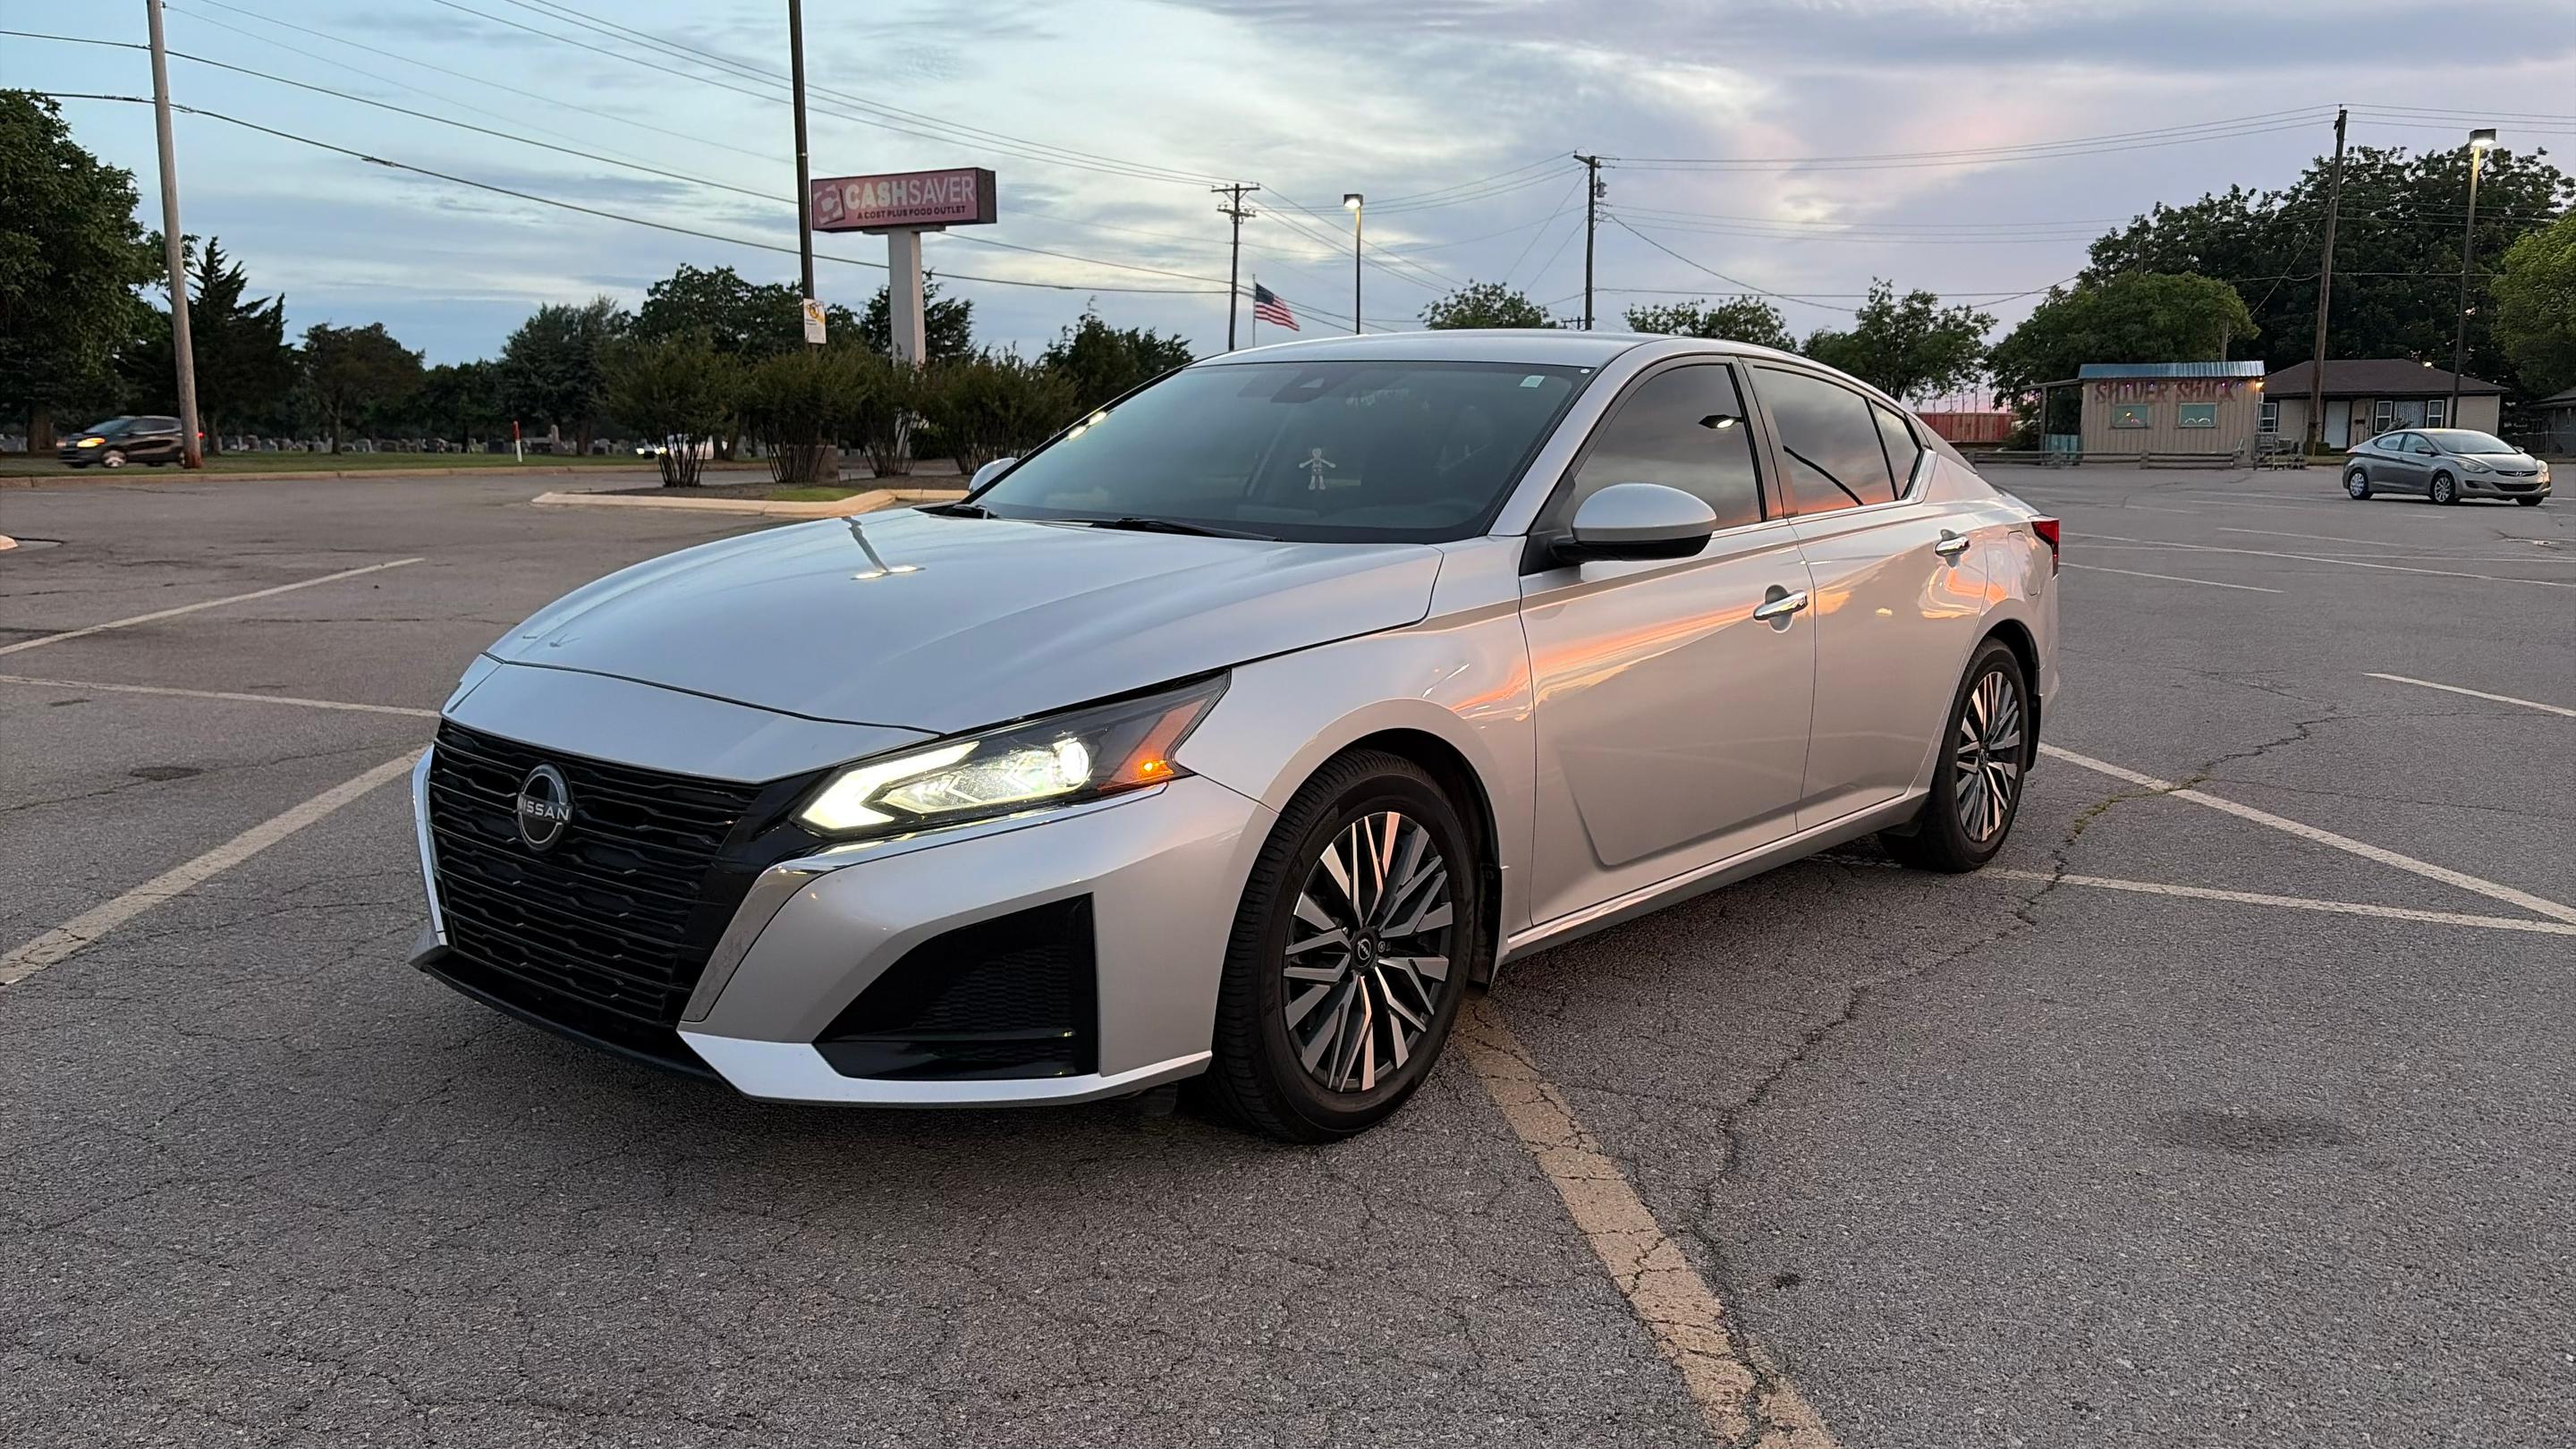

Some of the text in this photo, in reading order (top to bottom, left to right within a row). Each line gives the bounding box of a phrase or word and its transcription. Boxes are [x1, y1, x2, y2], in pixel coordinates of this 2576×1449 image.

[857, 205, 966, 220] A COST PLUS FOOD OUTLET
[519, 796, 569, 820] NISSAN
